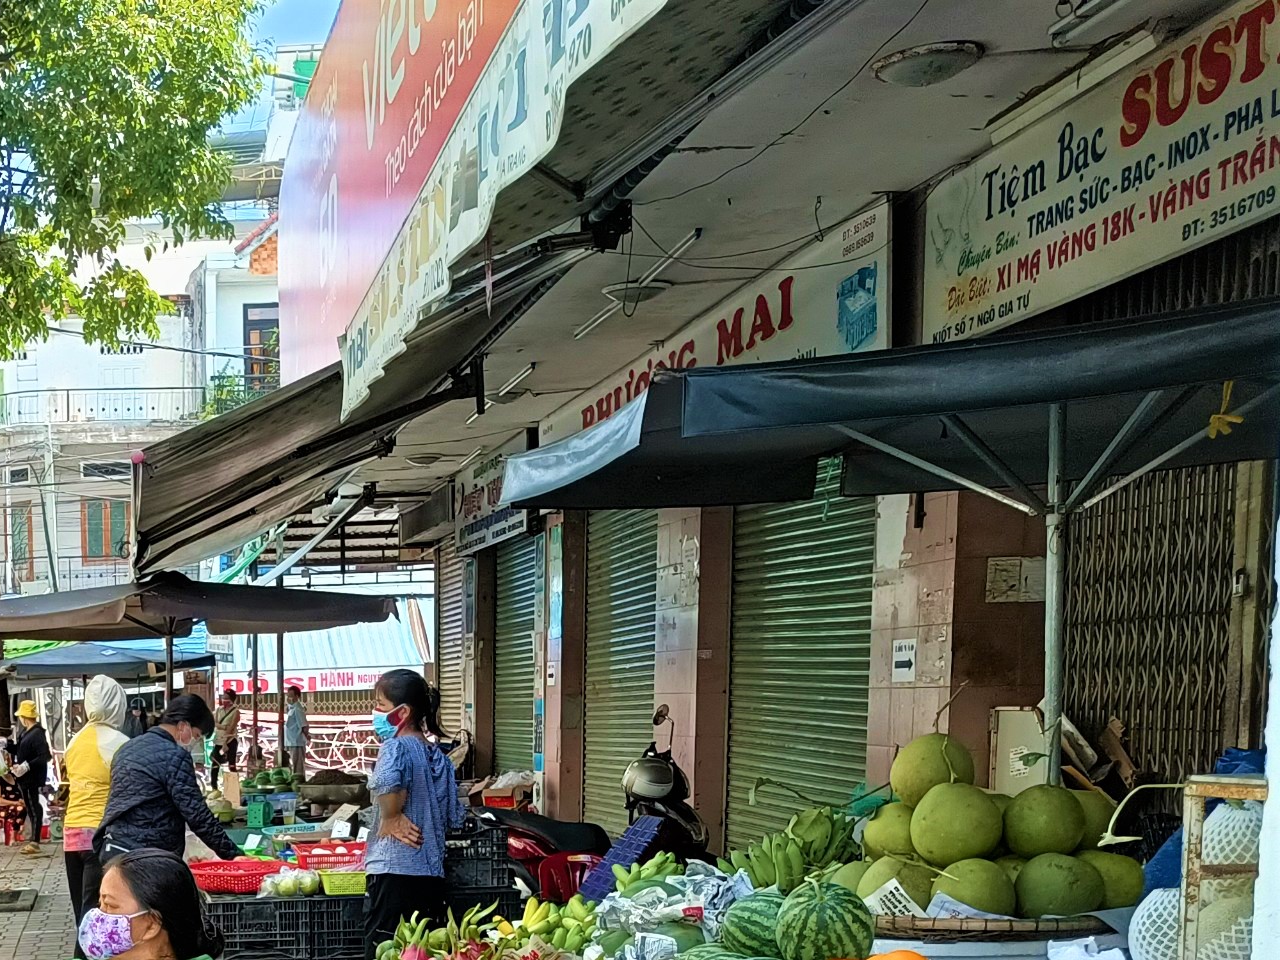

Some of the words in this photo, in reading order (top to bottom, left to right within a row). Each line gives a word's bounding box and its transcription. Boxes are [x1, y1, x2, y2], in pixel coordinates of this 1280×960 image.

[384, 135, 407, 198] Theo
[407, 80, 431, 158] cách
[433, 38, 455, 110] của
[457, 0, 484, 67] bạn
[1120, 0, 1280, 148] SUST
[981, 158, 1046, 222] Tiệm
[1056, 122, 1108, 184] Bạc
[1181, 217, 1205, 242] ĐT:
[1209, 185, 1277, 229] 3516709
[947, 282, 965, 312] Đặc
[996, 262, 1011, 293] XI
[1019, 249, 1041, 285] MẠ
[1046, 222, 1097, 270] VÀNG
[1102, 203, 1137, 245] 18K
[1148, 167, 1211, 223] VÀNG
[957, 238, 992, 276] Chuyên
[1026, 196, 1075, 239] TRANG
[716, 275, 794, 365] MAI
[932, 325, 952, 345] KIỐT
[954, 313, 966, 335] SỐ
[968, 316, 974, 331] 7
[977, 306, 995, 328] NGÔ
[998, 301, 1014, 322] GIA
[1016, 290, 1032, 319] TỰ
